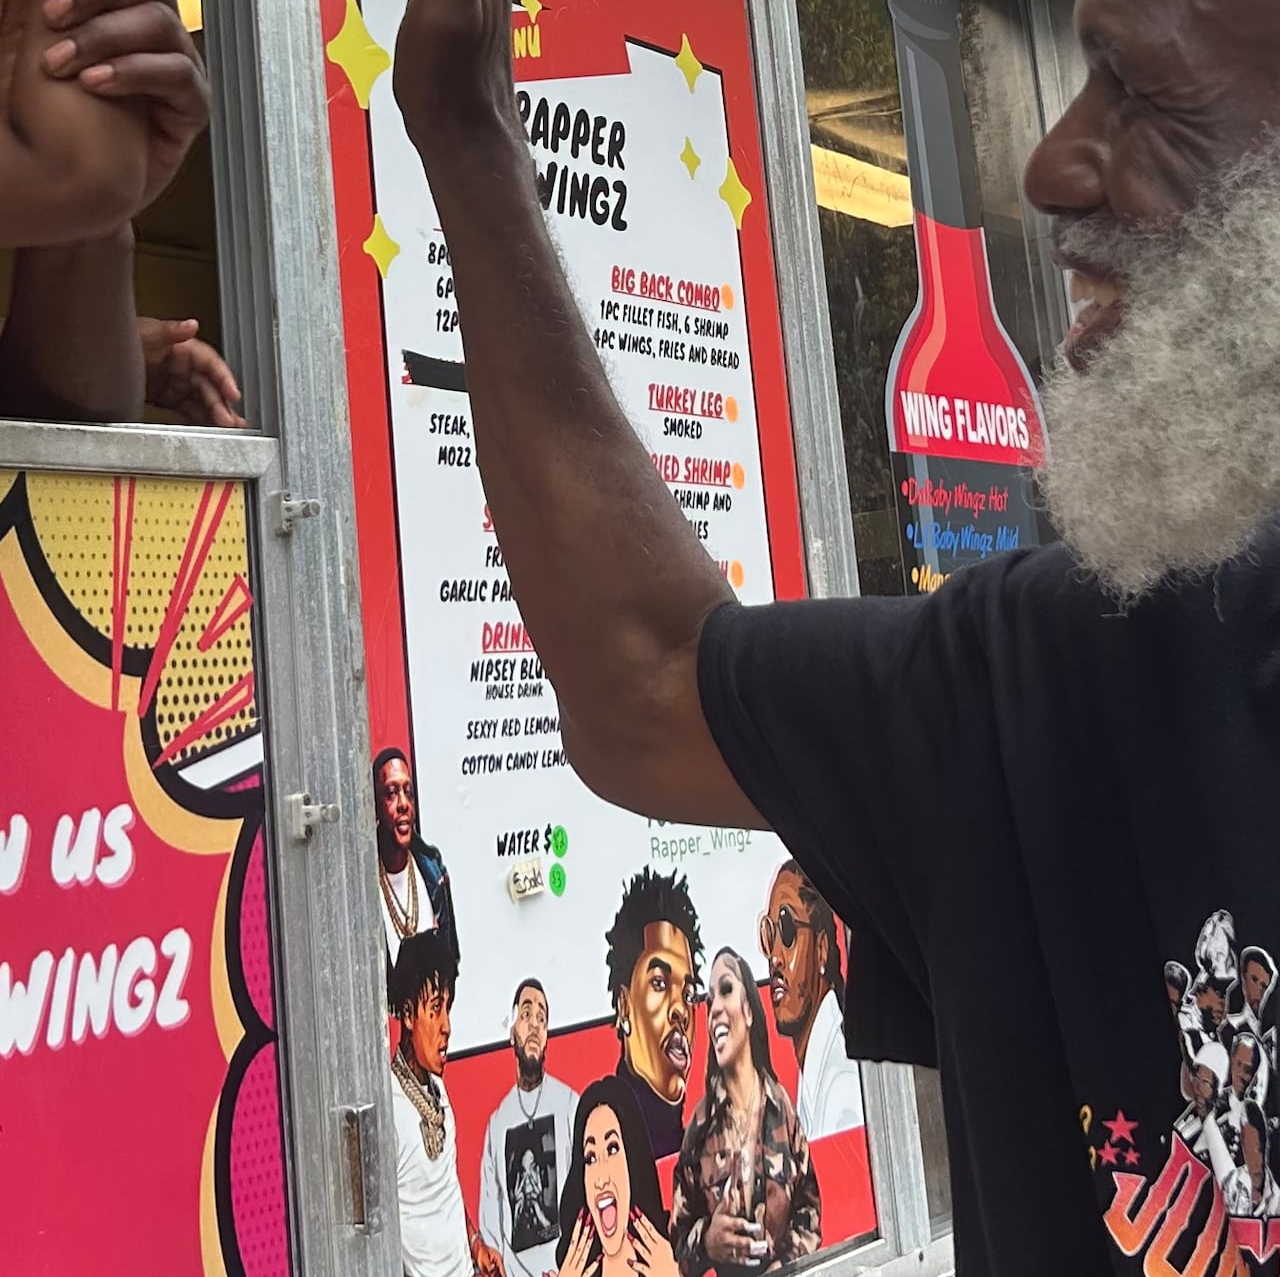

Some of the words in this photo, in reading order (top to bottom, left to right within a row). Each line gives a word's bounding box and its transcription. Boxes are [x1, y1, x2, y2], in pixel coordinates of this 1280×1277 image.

[512, 23, 542, 59] NU
[436, 276, 454, 298] 6P
[611, 265, 636, 294] BIG
[640, 271, 673, 300] BACK
[677, 280, 721, 310] COMBO
[436, 309, 459, 332] 12P
[600, 299, 620, 321] 1PC
[622, 304, 654, 328] FILLET
[657, 310, 682, 335] FISH,
[684, 315, 691, 334] 6
[693, 317, 729, 341] SHRIMP
[593, 327, 615, 350] 4PC
[618, 333, 656, 359] WINGS,
[658, 339, 685, 362] FRIES
[688, 345, 708, 365] AND
[710, 348, 740, 370] BREAD
[648, 383, 697, 414] TURKEY
[700, 390, 724, 418] LEG
[429, 414, 470, 439] STEAK,
[663, 418, 702, 439] SMOKED
[900, 390, 953, 441] WING
[953, 398, 1030, 450] FLAVORS
[683, 456, 731, 485] SHRIMP
[713, 492, 732, 512] AND
[954, 483, 986, 519] Wingz
[931, 521, 960, 559] Baby
[960, 524, 993, 559] Wingz
[440, 579, 488, 603] GARLIC
[918, 563, 951, 593] Man
[470, 658, 516, 682] NIPSEY
[520, 658, 549, 680] BLU
[485, 684, 515, 700] HOUSE
[517, 682, 544, 699] DRINK
[501, 719, 521, 737] RED
[462, 754, 503, 775] COTTON
[506, 750, 539, 771] CANDY
[541, 748, 571, 769] LEMO
[50, 802, 135, 888] us
[497, 828, 539, 857] WATER
